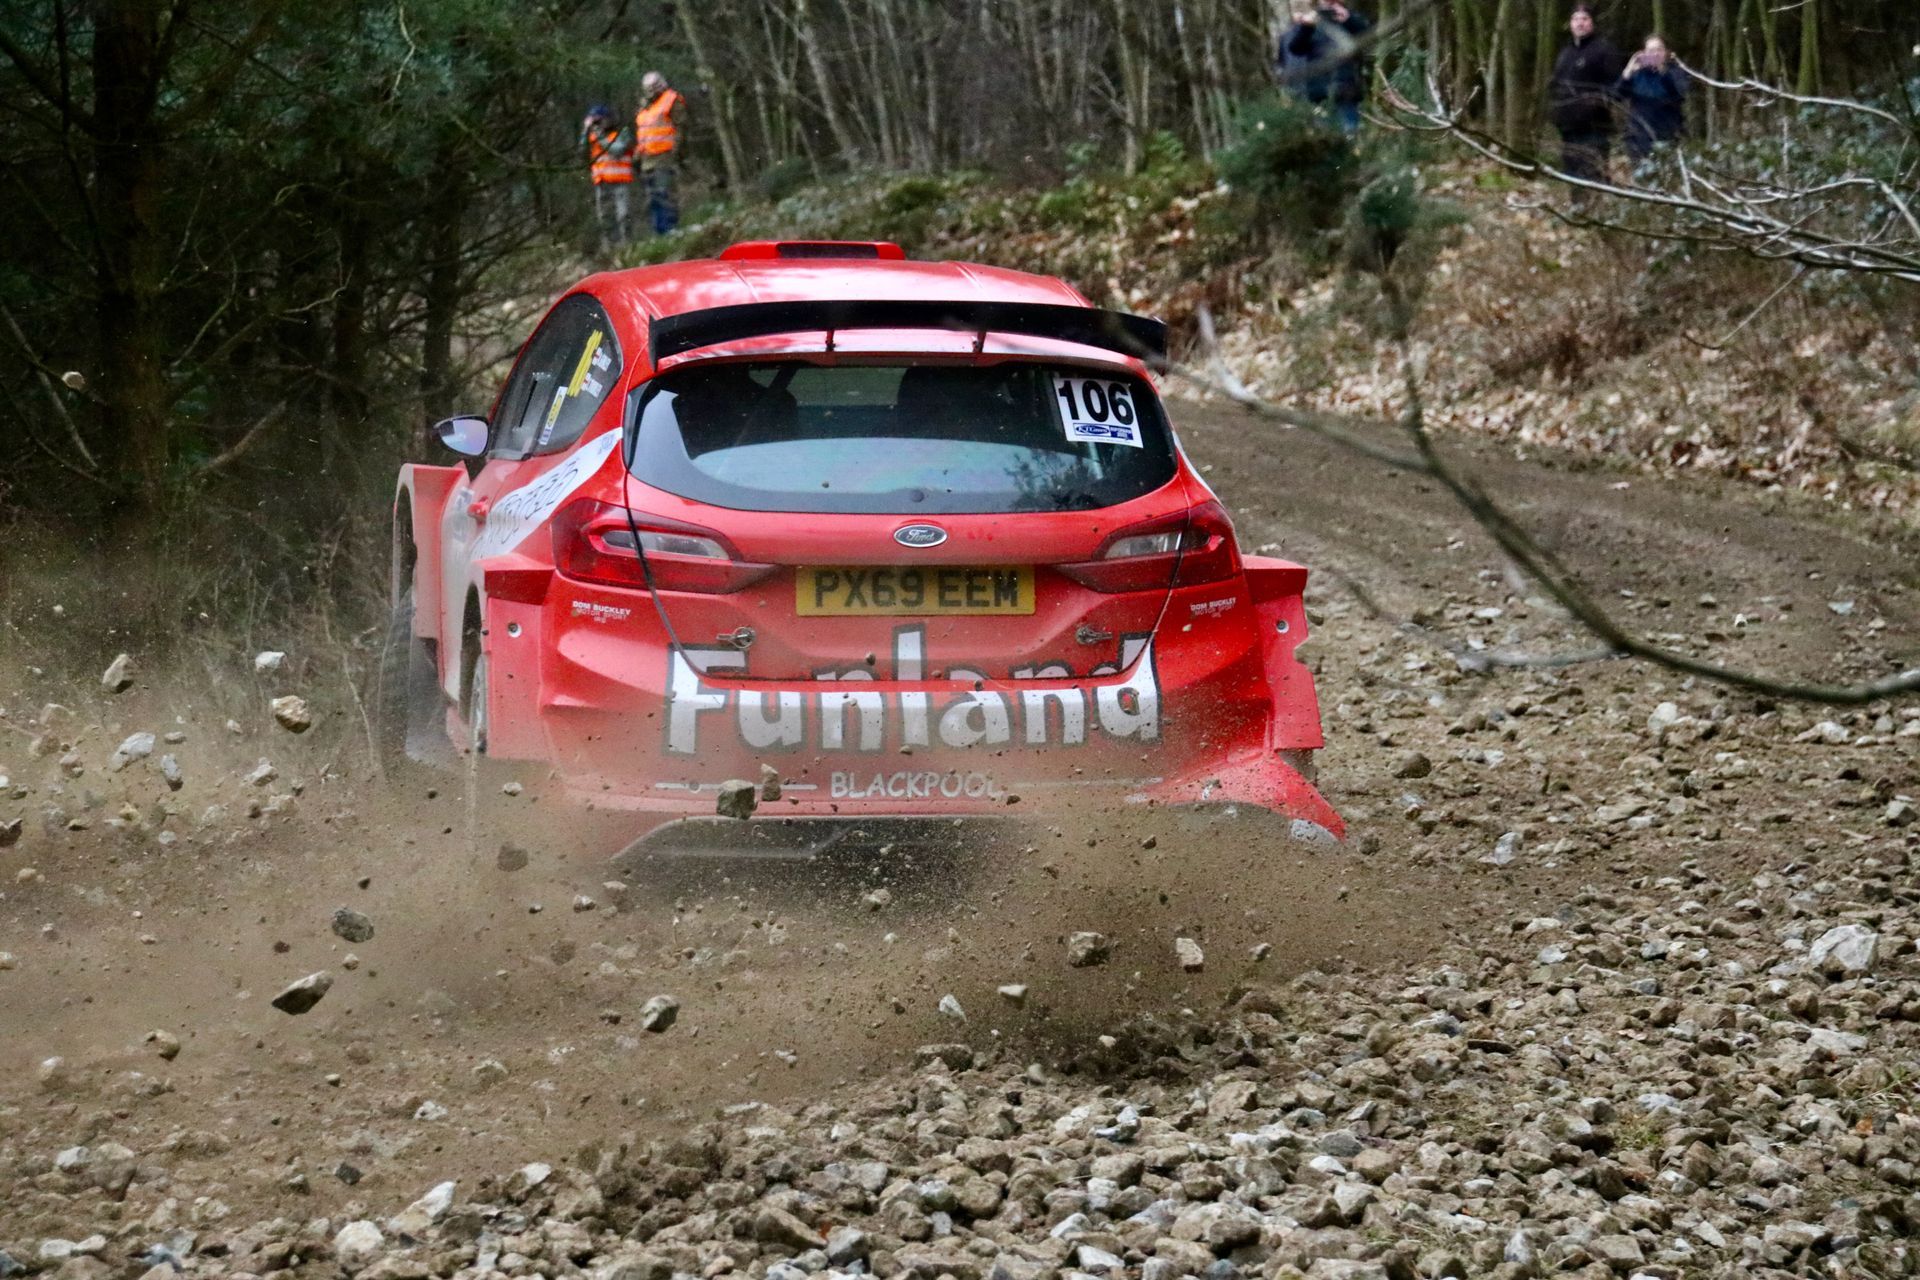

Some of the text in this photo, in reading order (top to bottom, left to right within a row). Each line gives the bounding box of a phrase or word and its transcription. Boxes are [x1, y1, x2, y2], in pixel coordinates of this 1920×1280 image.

[1058, 380, 1134, 425] 106
[906, 529, 935, 542] Ford
[814, 569, 1018, 608] PX69 EEM
[573, 600, 631, 615] DOM BUCKLEY
[1191, 597, 1236, 611] DOM BUCKLEY
[664, 622, 1163, 756] Funland
[830, 771, 1005, 800] BLACKPOOL
